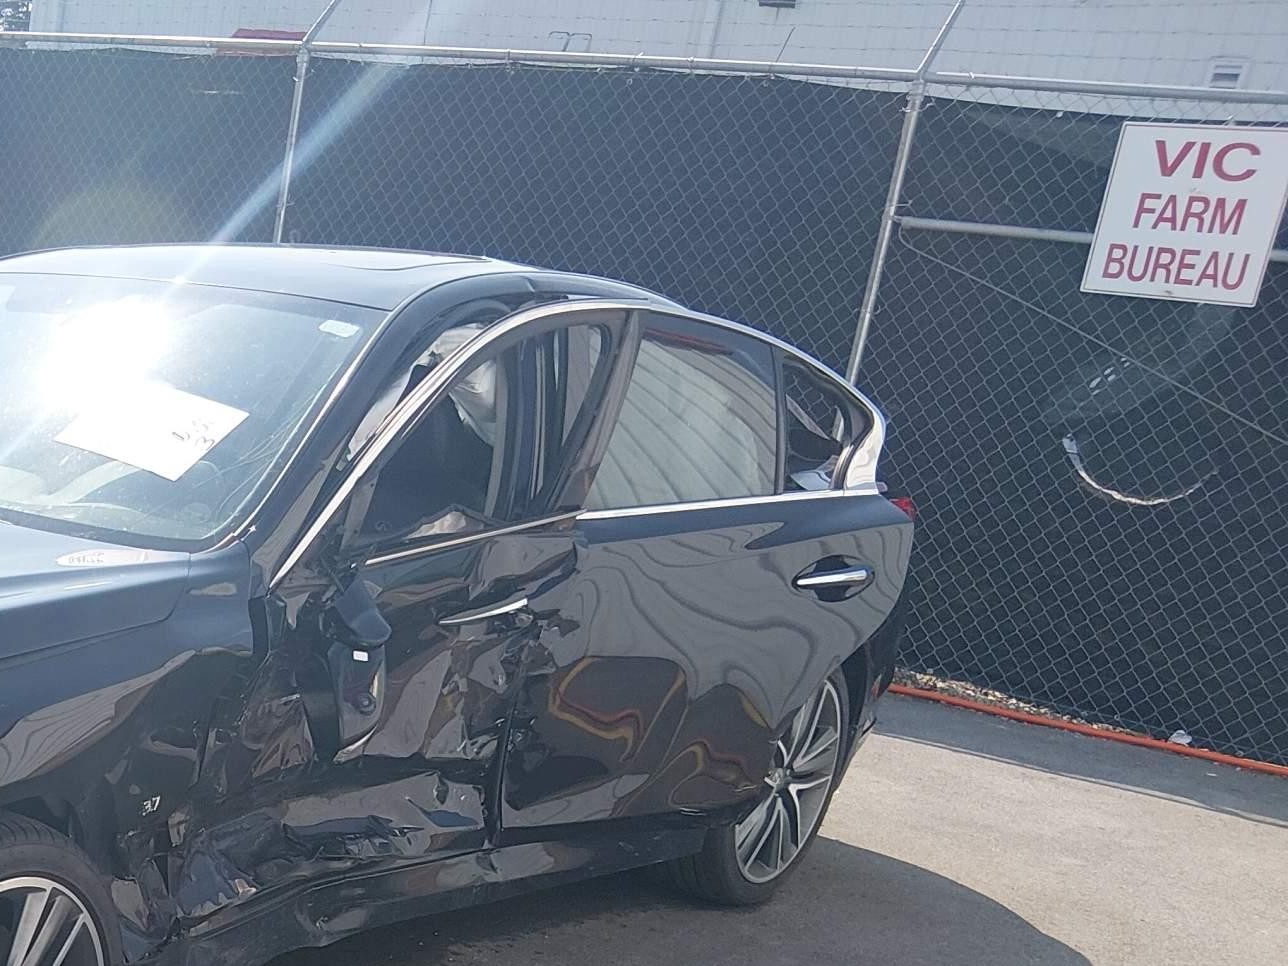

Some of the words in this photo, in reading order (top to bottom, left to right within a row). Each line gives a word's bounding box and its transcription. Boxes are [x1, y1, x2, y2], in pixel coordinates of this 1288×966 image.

[1155, 140, 1261, 181] VIC
[1132, 193, 1248, 235] FARM
[1102, 243, 1251, 290] BUREAU
